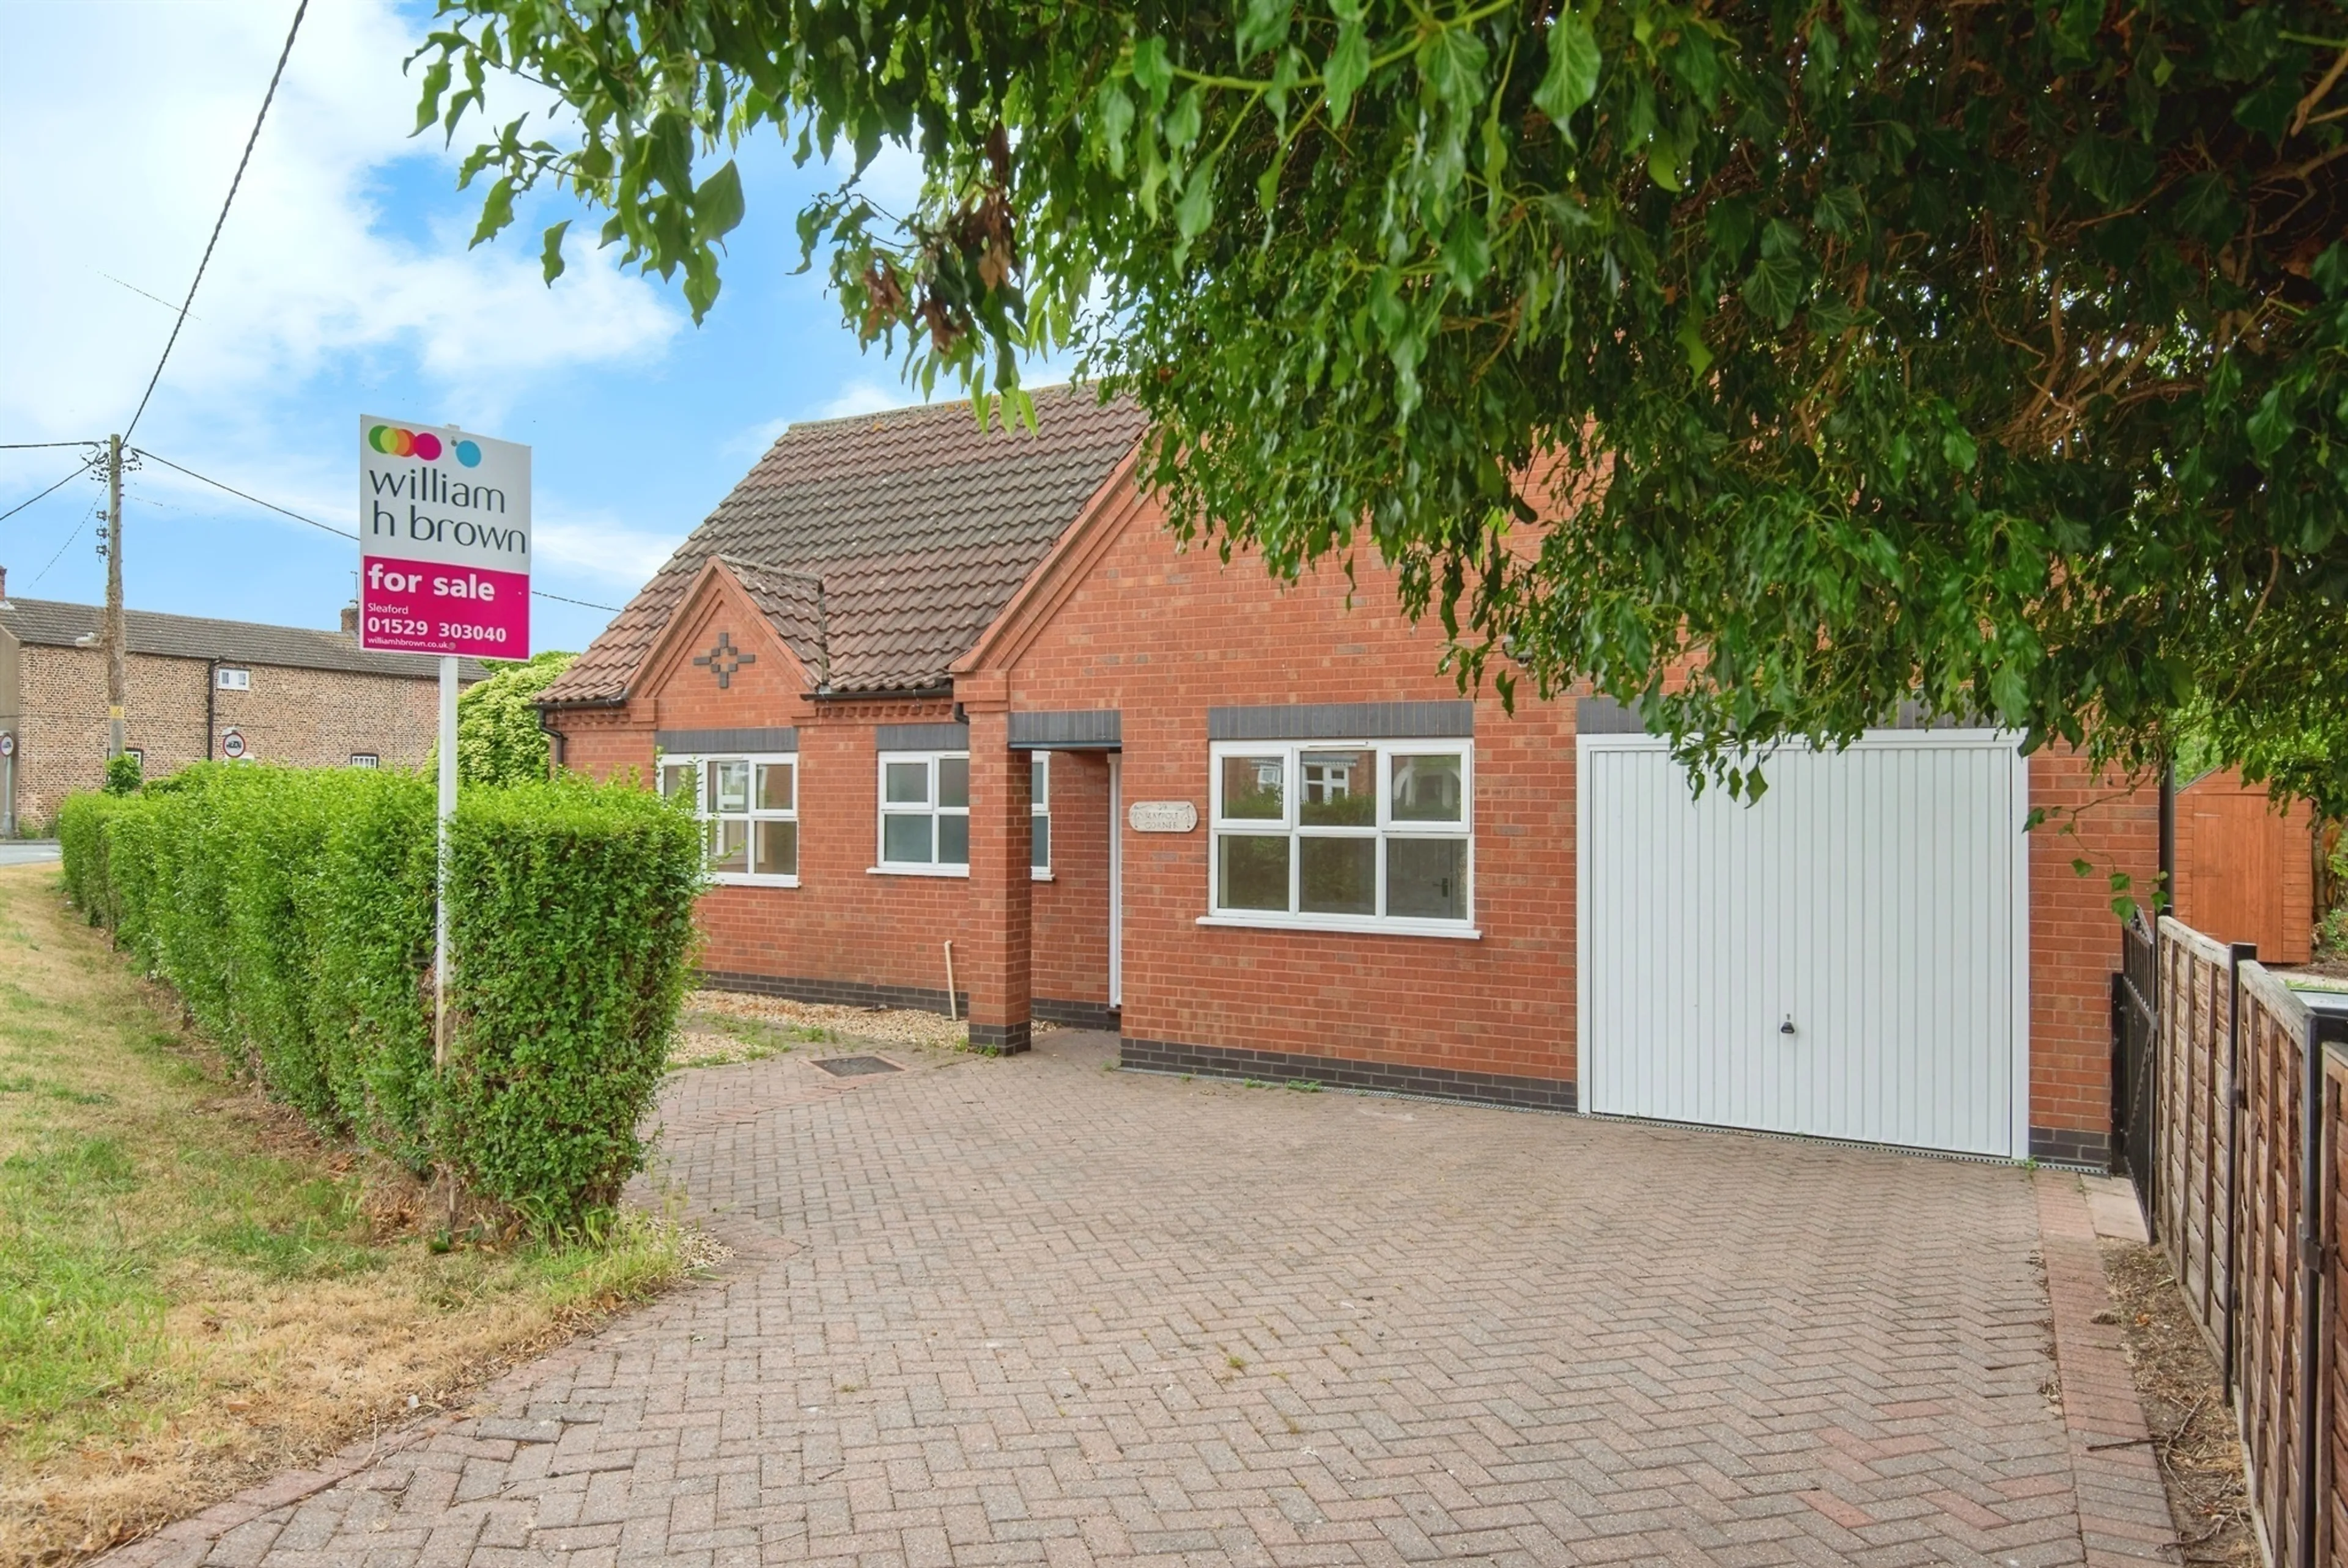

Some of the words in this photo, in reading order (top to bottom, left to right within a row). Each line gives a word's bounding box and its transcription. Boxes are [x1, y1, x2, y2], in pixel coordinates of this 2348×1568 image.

[369, 466, 504, 513] william
[374, 500, 395, 537] h
[410, 505, 525, 553] brown
[368, 564, 423, 593] for
[433, 574, 495, 601] sale
[367, 603, 408, 614] Sleaford
[367, 617, 428, 636] 01529
[438, 622, 506, 642] 303040
[367, 636, 448, 649] williamhbrown.co.uk
